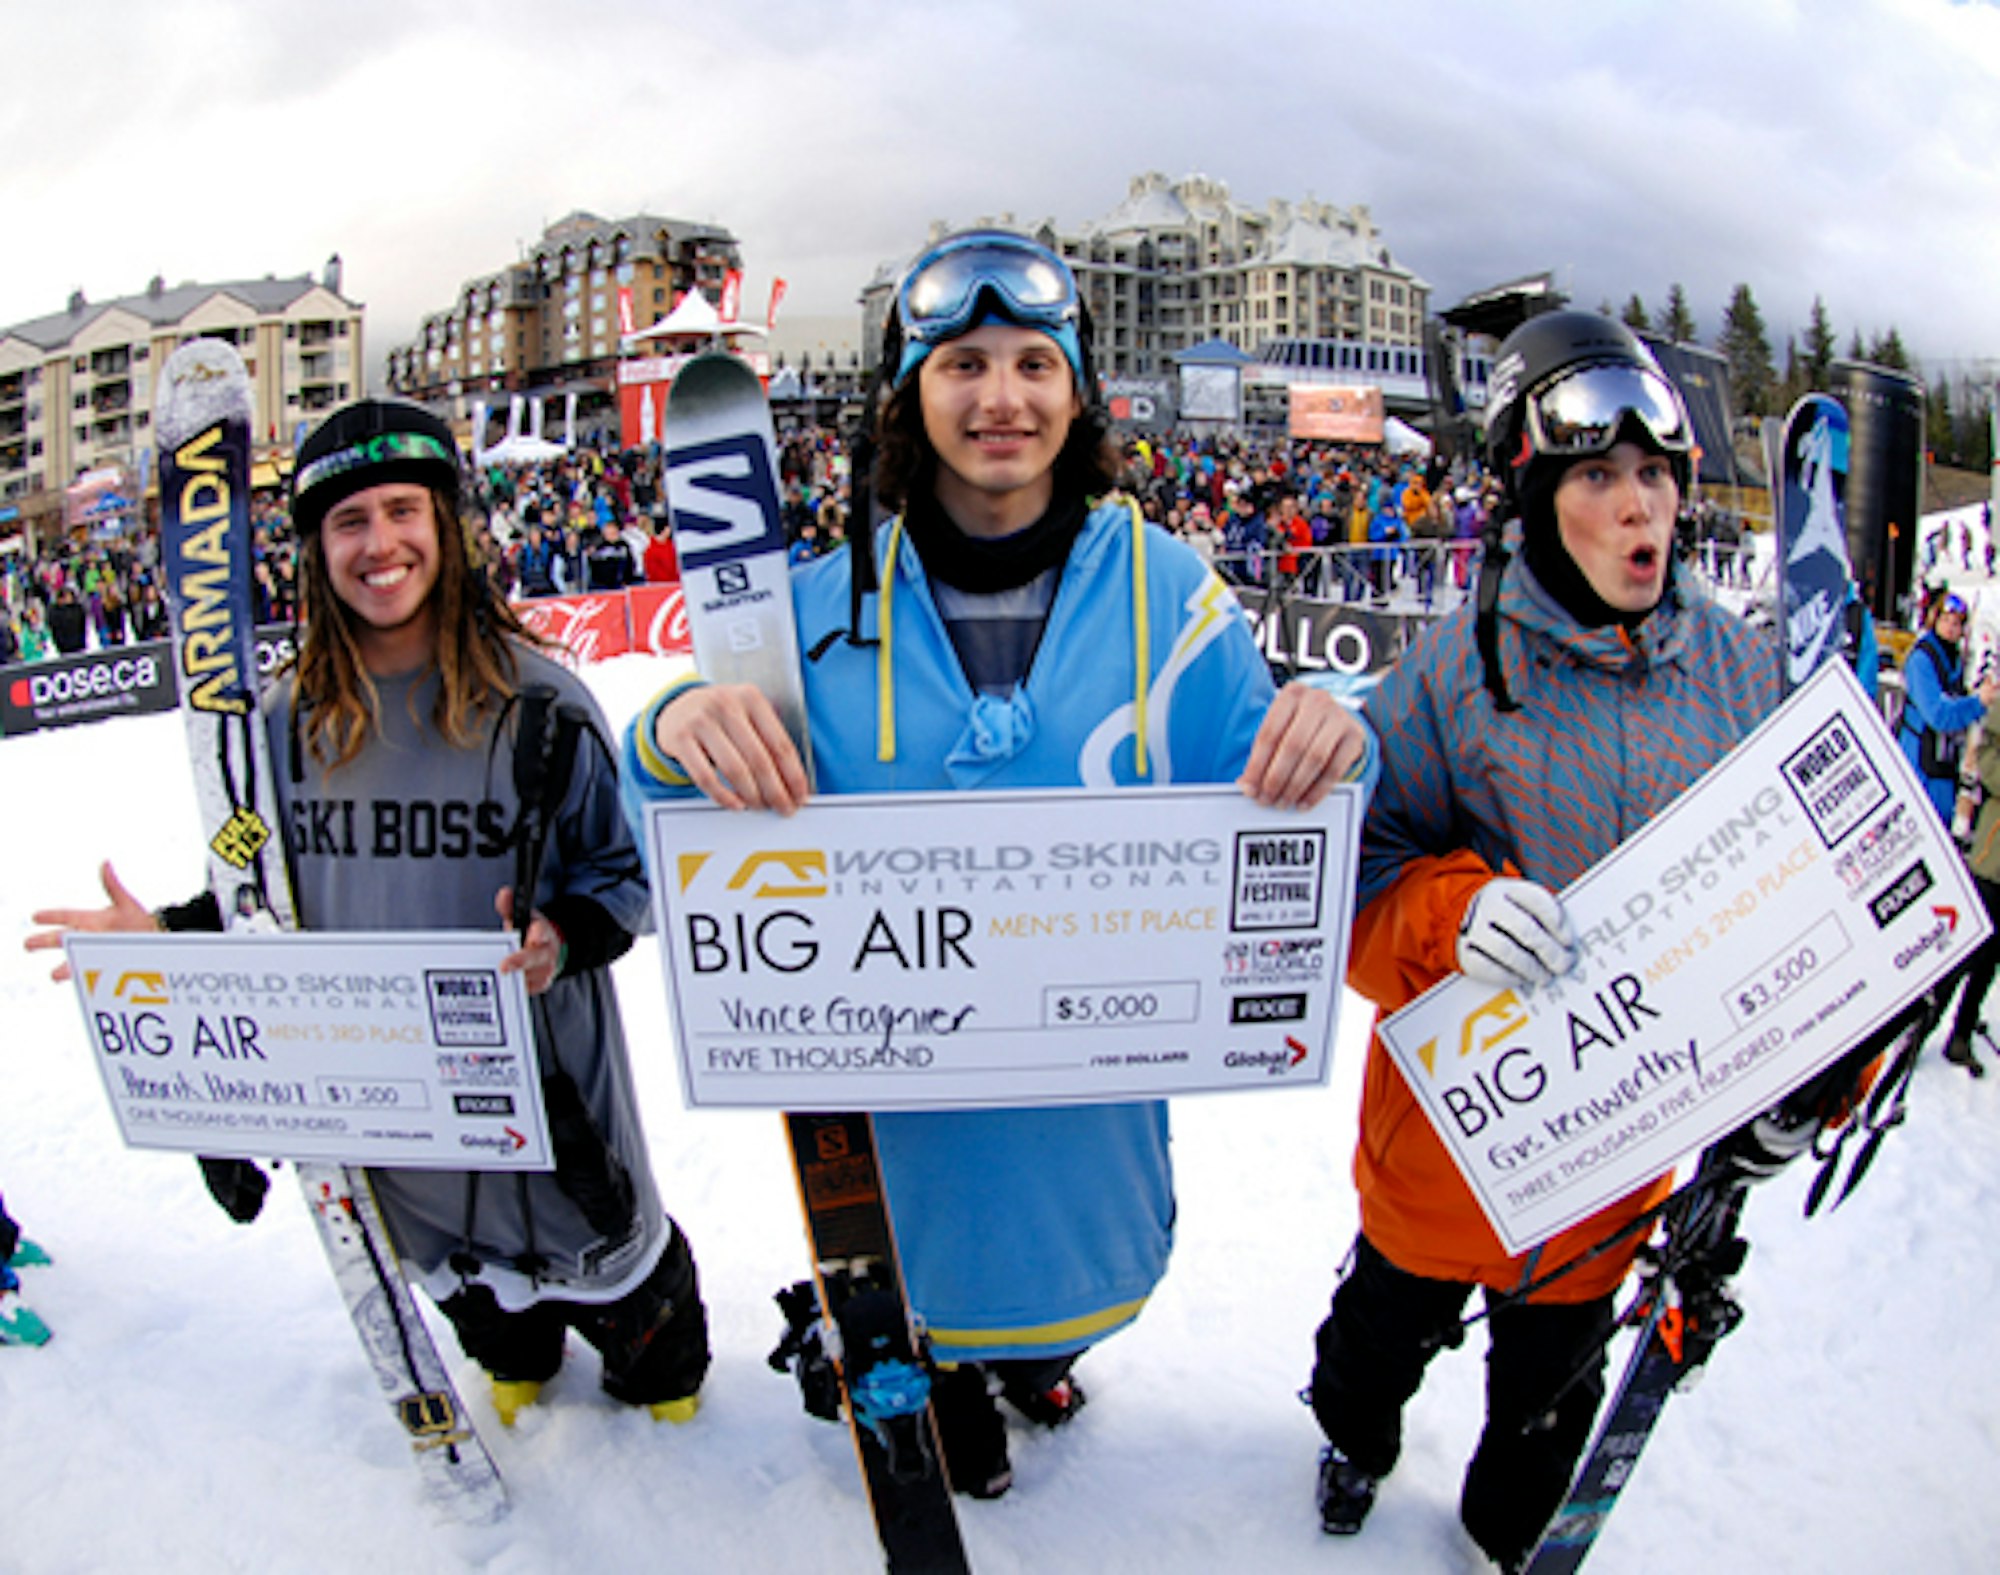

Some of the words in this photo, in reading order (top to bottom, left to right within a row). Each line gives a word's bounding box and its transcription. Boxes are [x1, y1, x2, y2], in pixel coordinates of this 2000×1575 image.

[178, 425, 247, 715] ARMADA
[1792, 729, 1850, 787] WORLD
[291, 799, 358, 856] SKI
[371, 799, 506, 859] BOSS
[1244, 839, 1315, 867] WORLD
[1660, 786, 1783, 895] SKIING
[834, 845, 1034, 876] WORLD
[1048, 838, 1222, 870] SKIING
[834, 869, 1221, 896] INVITATIONAL
[988, 911, 1080, 938] MEN'S
[1092, 909, 1135, 935] 1ST
[1140, 906, 1218, 934] PLACE
[1645, 925, 1710, 985] MEN'S
[1709, 889, 1757, 937] 2ND
[1756, 838, 1819, 898] PLACE
[686, 909, 819, 974] BIG
[851, 907, 977, 973] AIR
[1893, 919, 1945, 970] Global
[168, 972, 288, 993] WORLD
[296, 973, 418, 995] SKIING
[172, 995, 420, 1009] INVITATIONAL
[1737, 947, 1817, 1016] $3,500
[720, 997, 816, 1032] Vince
[826, 996, 978, 1051] Gagnier
[1056, 993, 1158, 1024] $5,000
[94, 1011, 174, 1057] BIG
[191, 1013, 269, 1061] AIR
[369, 1024, 426, 1044] PLACE
[707, 1048, 760, 1070] FIVE
[771, 1046, 934, 1070] THOUSAND
[1224, 1050, 1287, 1068] Global
[1442, 1047, 1547, 1138] BIG
[1566, 973, 1661, 1071] AIR
[1507, 1169, 1559, 1208] THREE
[1558, 1112, 1660, 1179] THOUSAND
[1659, 1085, 1696, 1120] FIVE
[1699, 1026, 1785, 1096] HUNDRED
